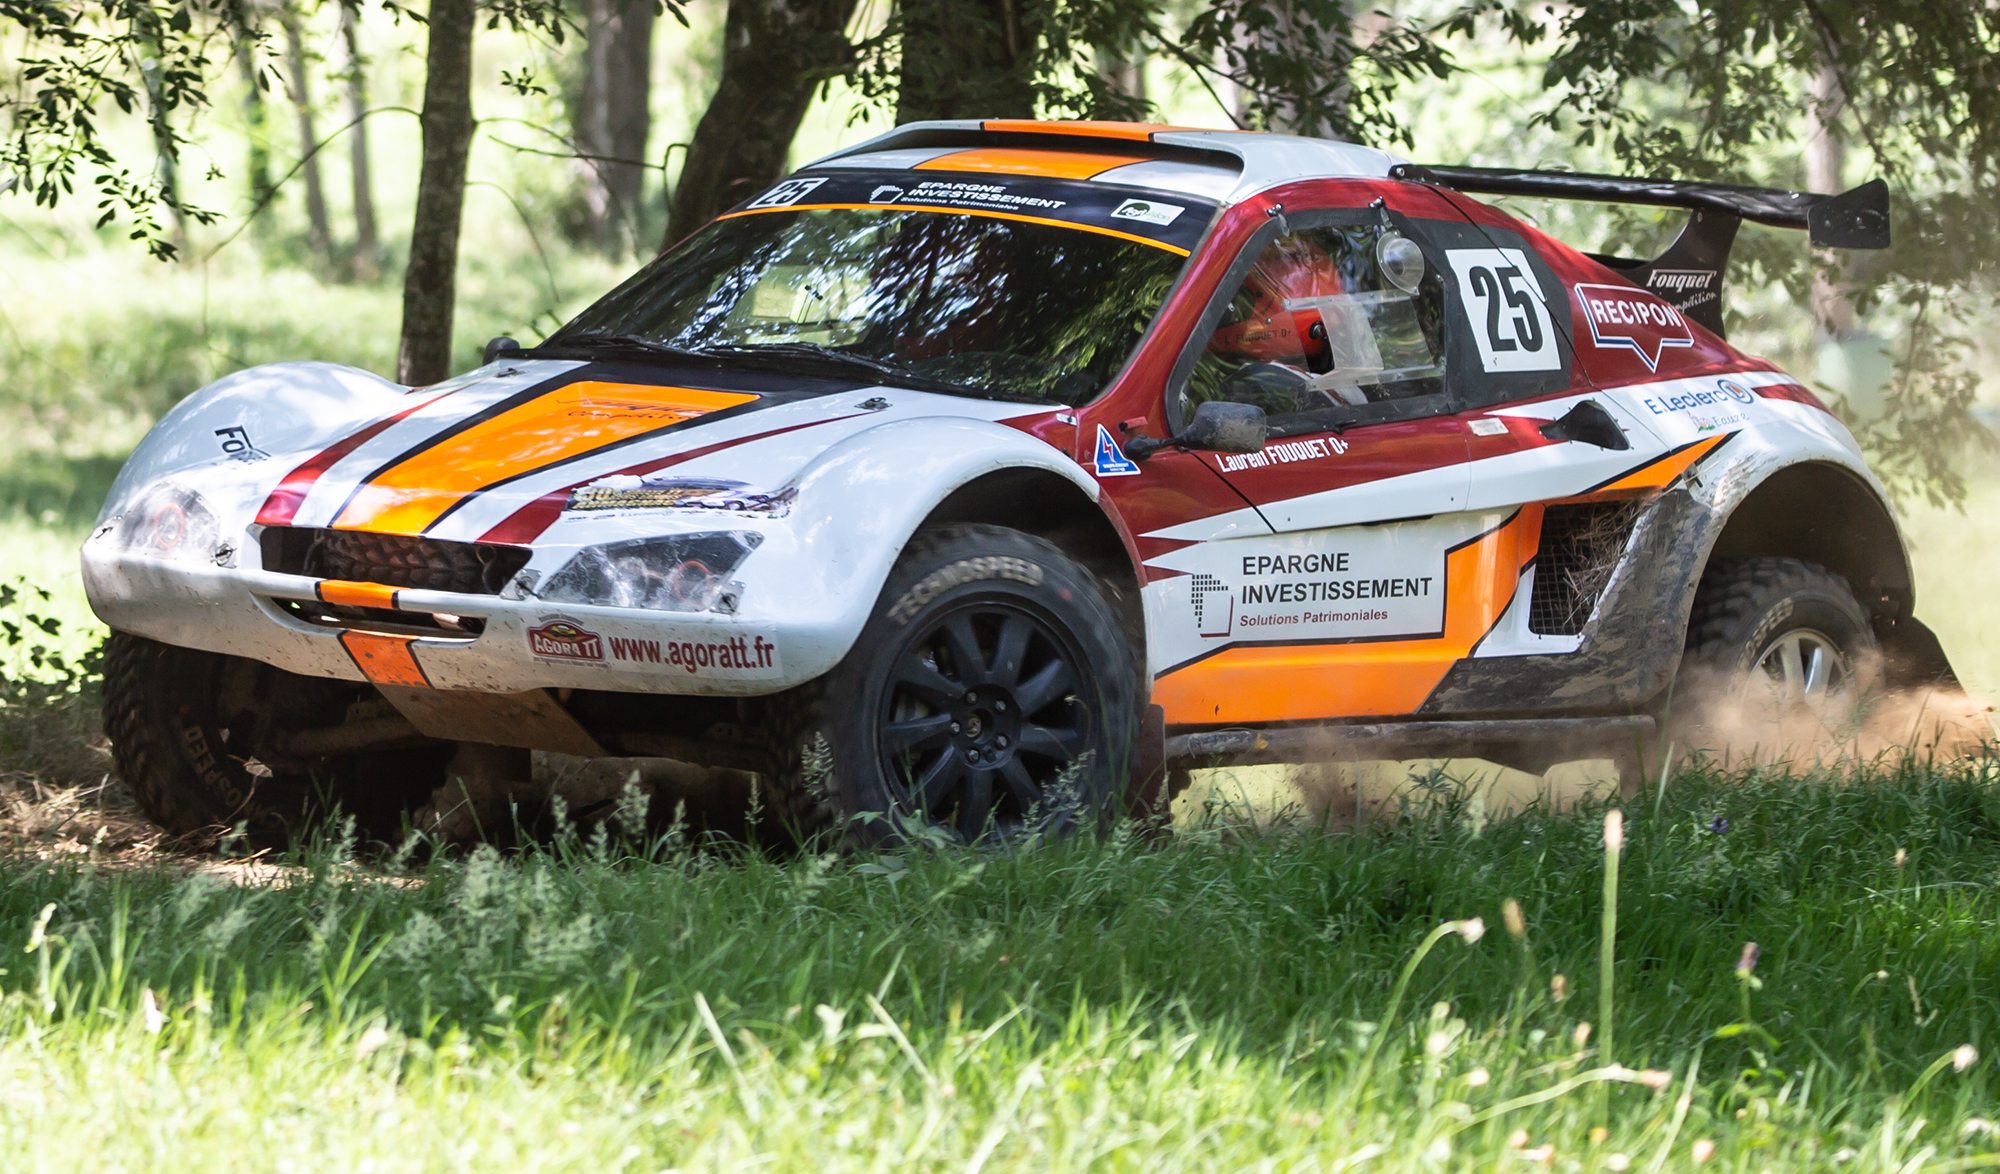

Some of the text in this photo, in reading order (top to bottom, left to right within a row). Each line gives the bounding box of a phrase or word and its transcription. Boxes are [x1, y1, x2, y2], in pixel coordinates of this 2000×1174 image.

[755, 181, 820, 205] 25
[908, 188, 1067, 209] INVESTISSEMENT
[917, 181, 1007, 193] EPARGNE
[900, 196, 1019, 211] Solutions Patrimoniales
[1646, 269, 1717, 293] Fouquet
[1468, 265, 1544, 353] 25
[1590, 299, 1682, 327] RECIPON
[1644, 389, 1728, 415] E.Leclerc
[1712, 412, 1750, 427] Eauze
[1215, 449, 1270, 473] Laurent
[1265, 439, 1331, 464] FOUQUET
[1242, 552, 1350, 576] EPARGNE
[1241, 577, 1433, 605] INVESTISSEMENT
[1239, 608, 1388, 627] Solutions Patrimoniales
[533, 633, 582, 656] AGORA
[608, 635, 775, 674] www.agoratt.fr
